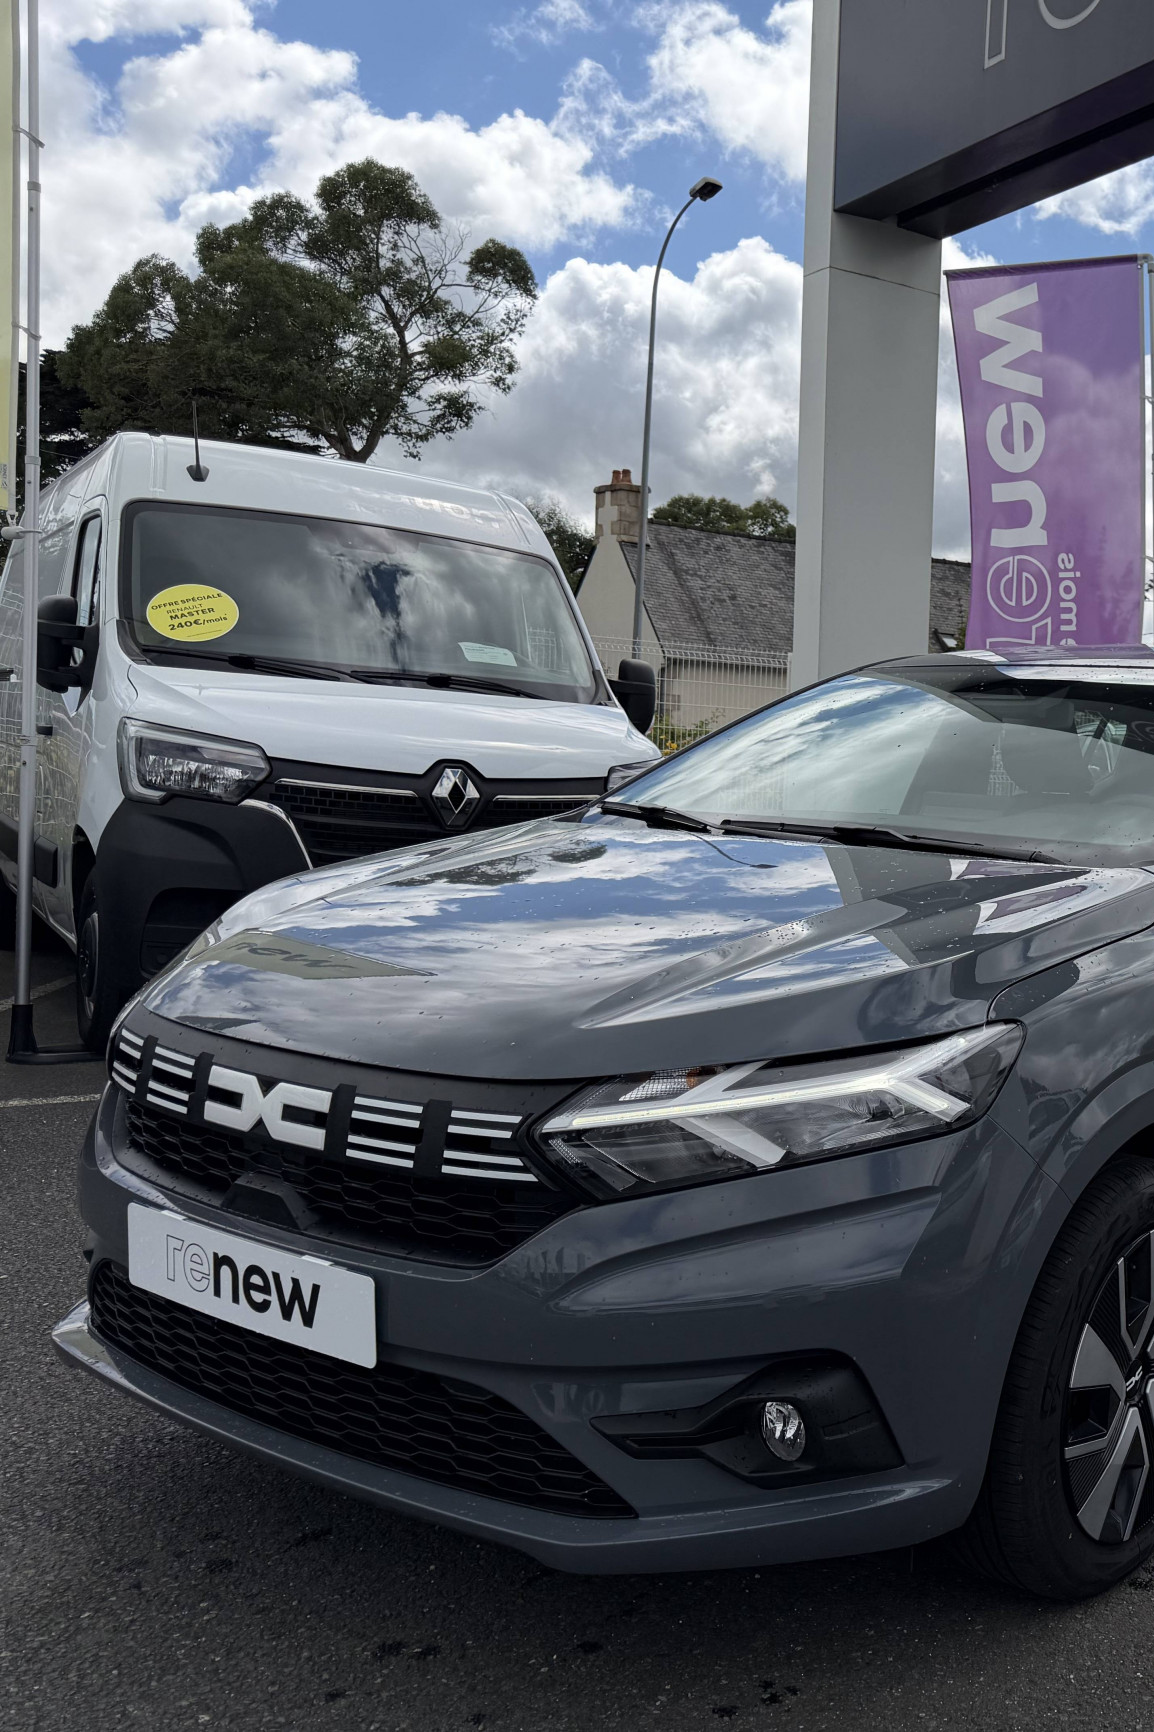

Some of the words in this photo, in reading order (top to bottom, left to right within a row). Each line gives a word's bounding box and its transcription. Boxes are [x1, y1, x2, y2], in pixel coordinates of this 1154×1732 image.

[151, 600, 179, 610] OFFRE
[181, 593, 223, 604] SPÉCIALE
[166, 603, 203, 614] RENAULT
[169, 607, 215, 620] MASTER
[166, 1234, 321, 1329] renew
